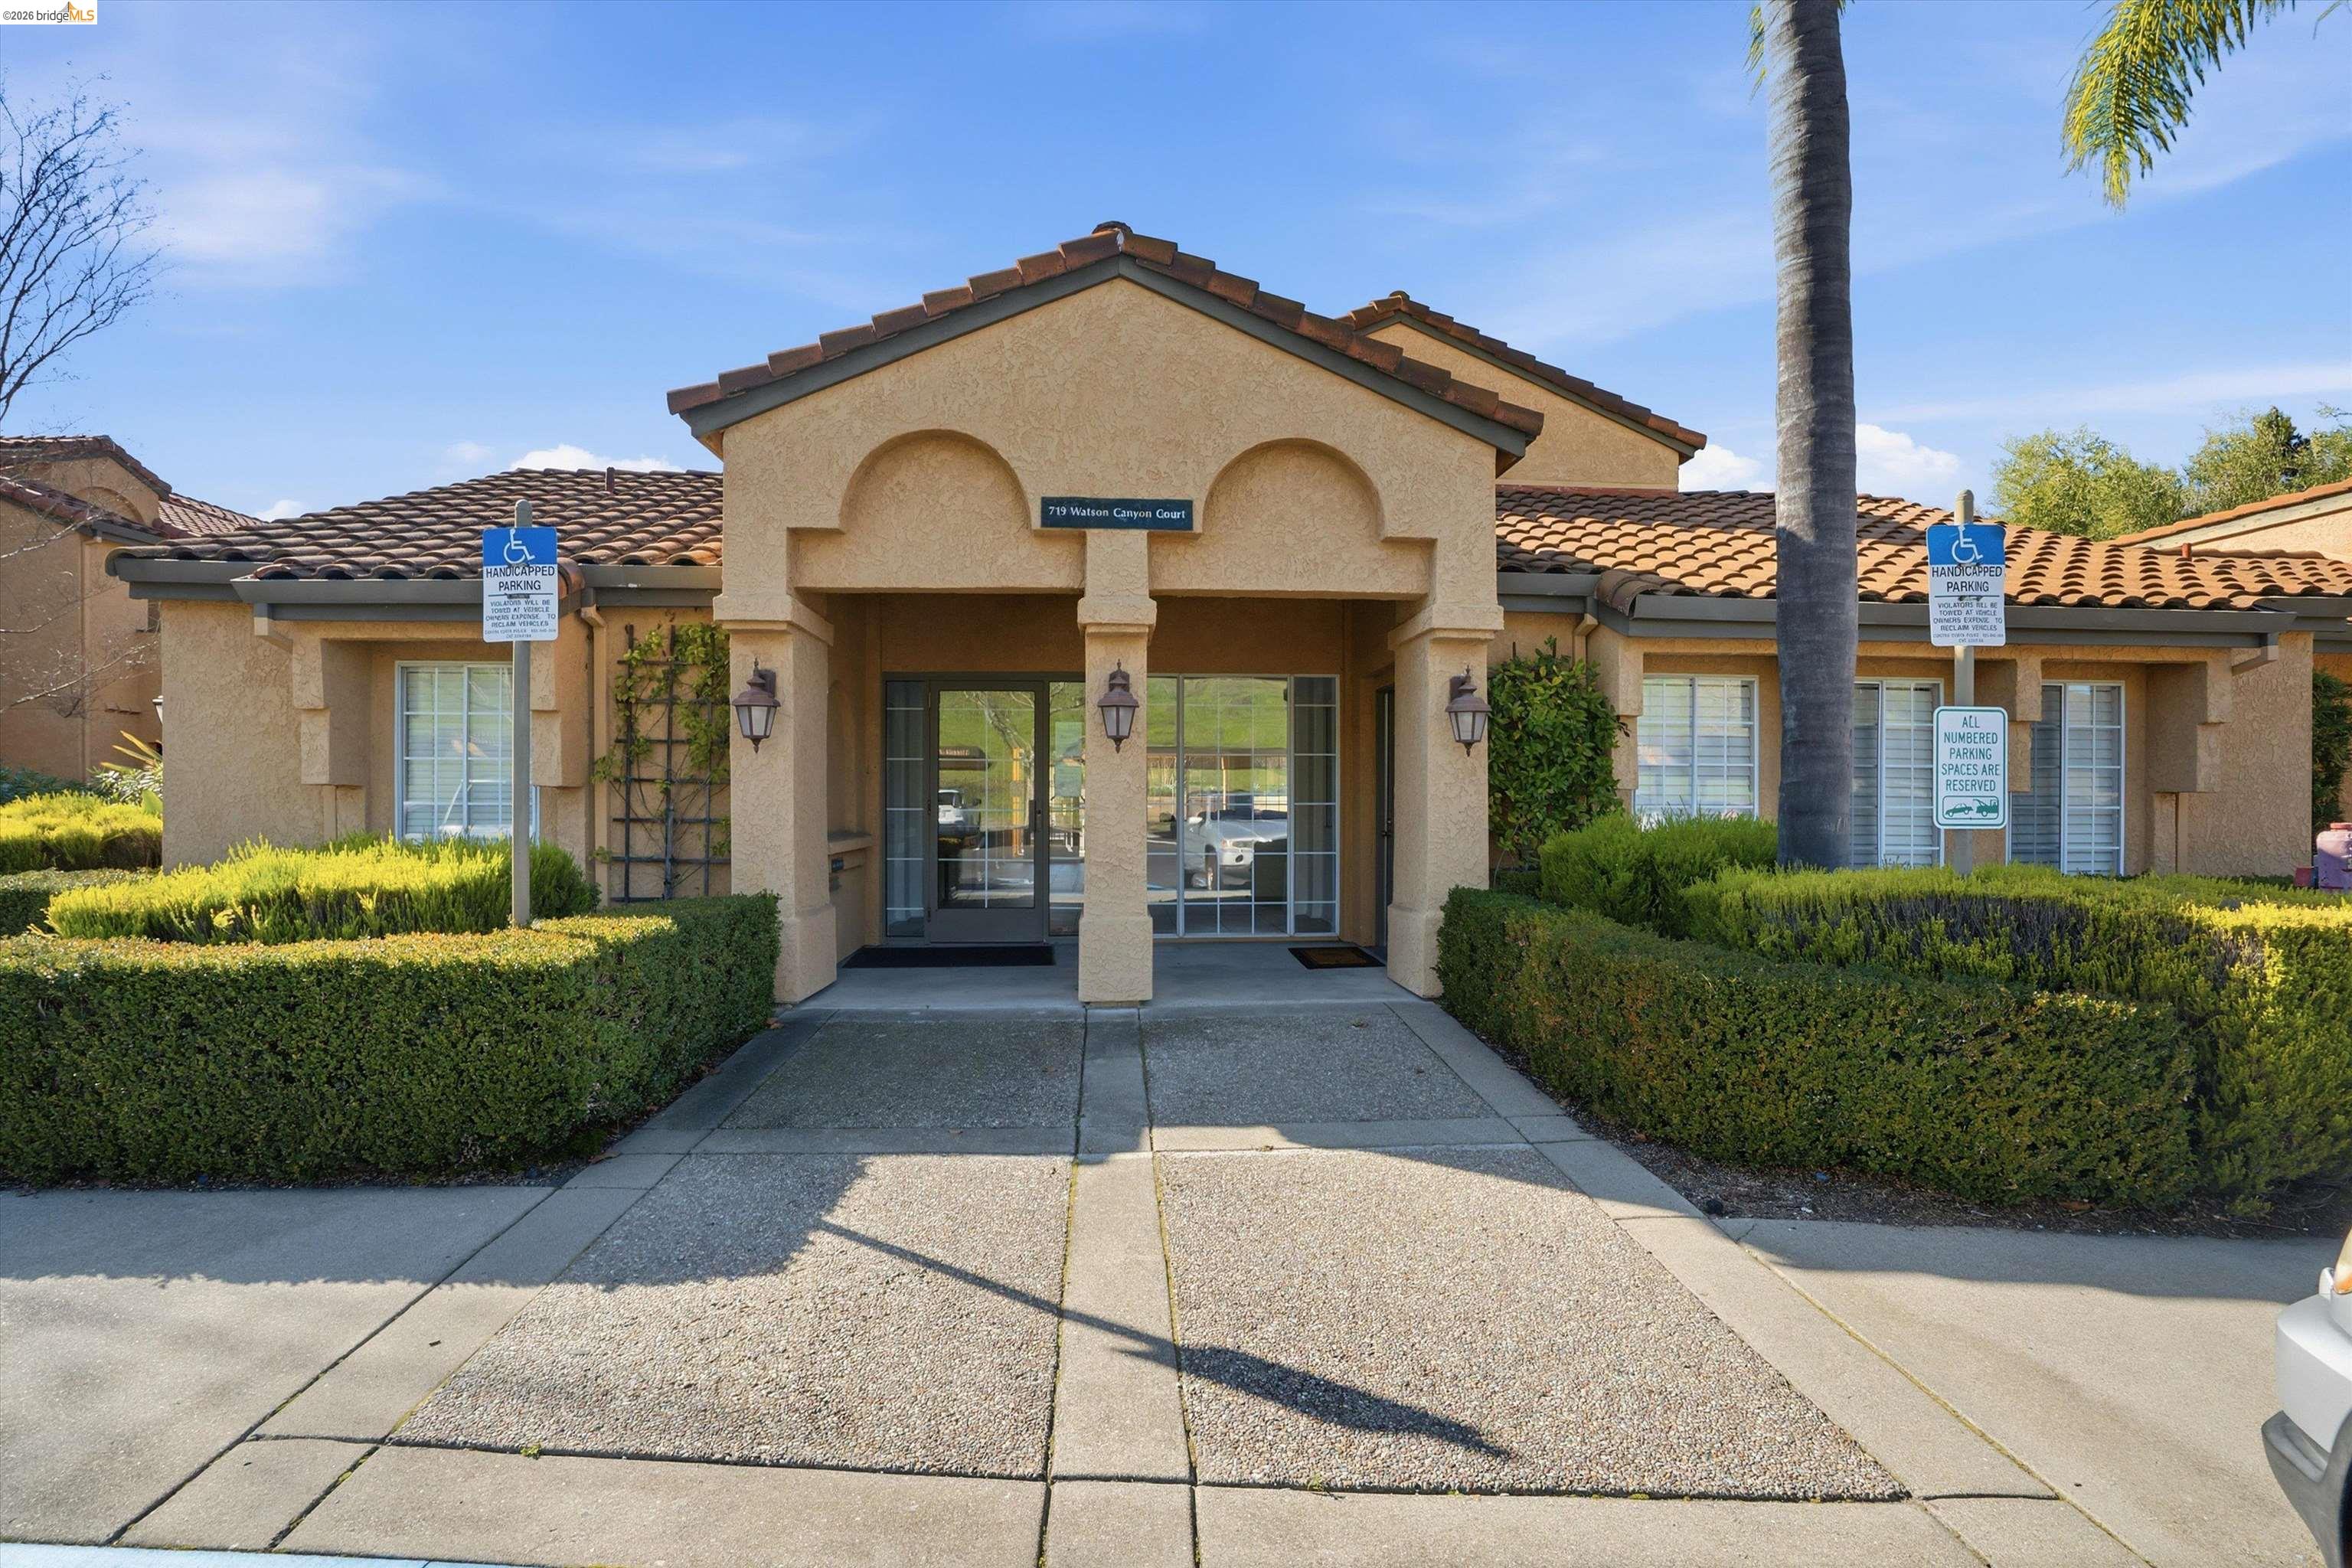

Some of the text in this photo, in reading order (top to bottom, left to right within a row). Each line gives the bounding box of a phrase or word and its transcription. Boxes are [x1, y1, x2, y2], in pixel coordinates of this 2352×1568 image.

[1049, 506, 1185, 520] 719 Watson Canyon Court
[486, 566, 555, 578] HANDICAPPED
[1932, 566, 2002, 577] HANDICAPPED
[498, 580, 541, 591] PARKING
[1946, 581, 1989, 593] PARKING
[1962, 716, 1980, 729] ALL
[1944, 732, 1998, 744] NUMBERED
[1949, 748, 1992, 760] PARKING
[1942, 763, 2001, 776] SPACES ARE
[1945, 779, 1996, 792] RESERVED
